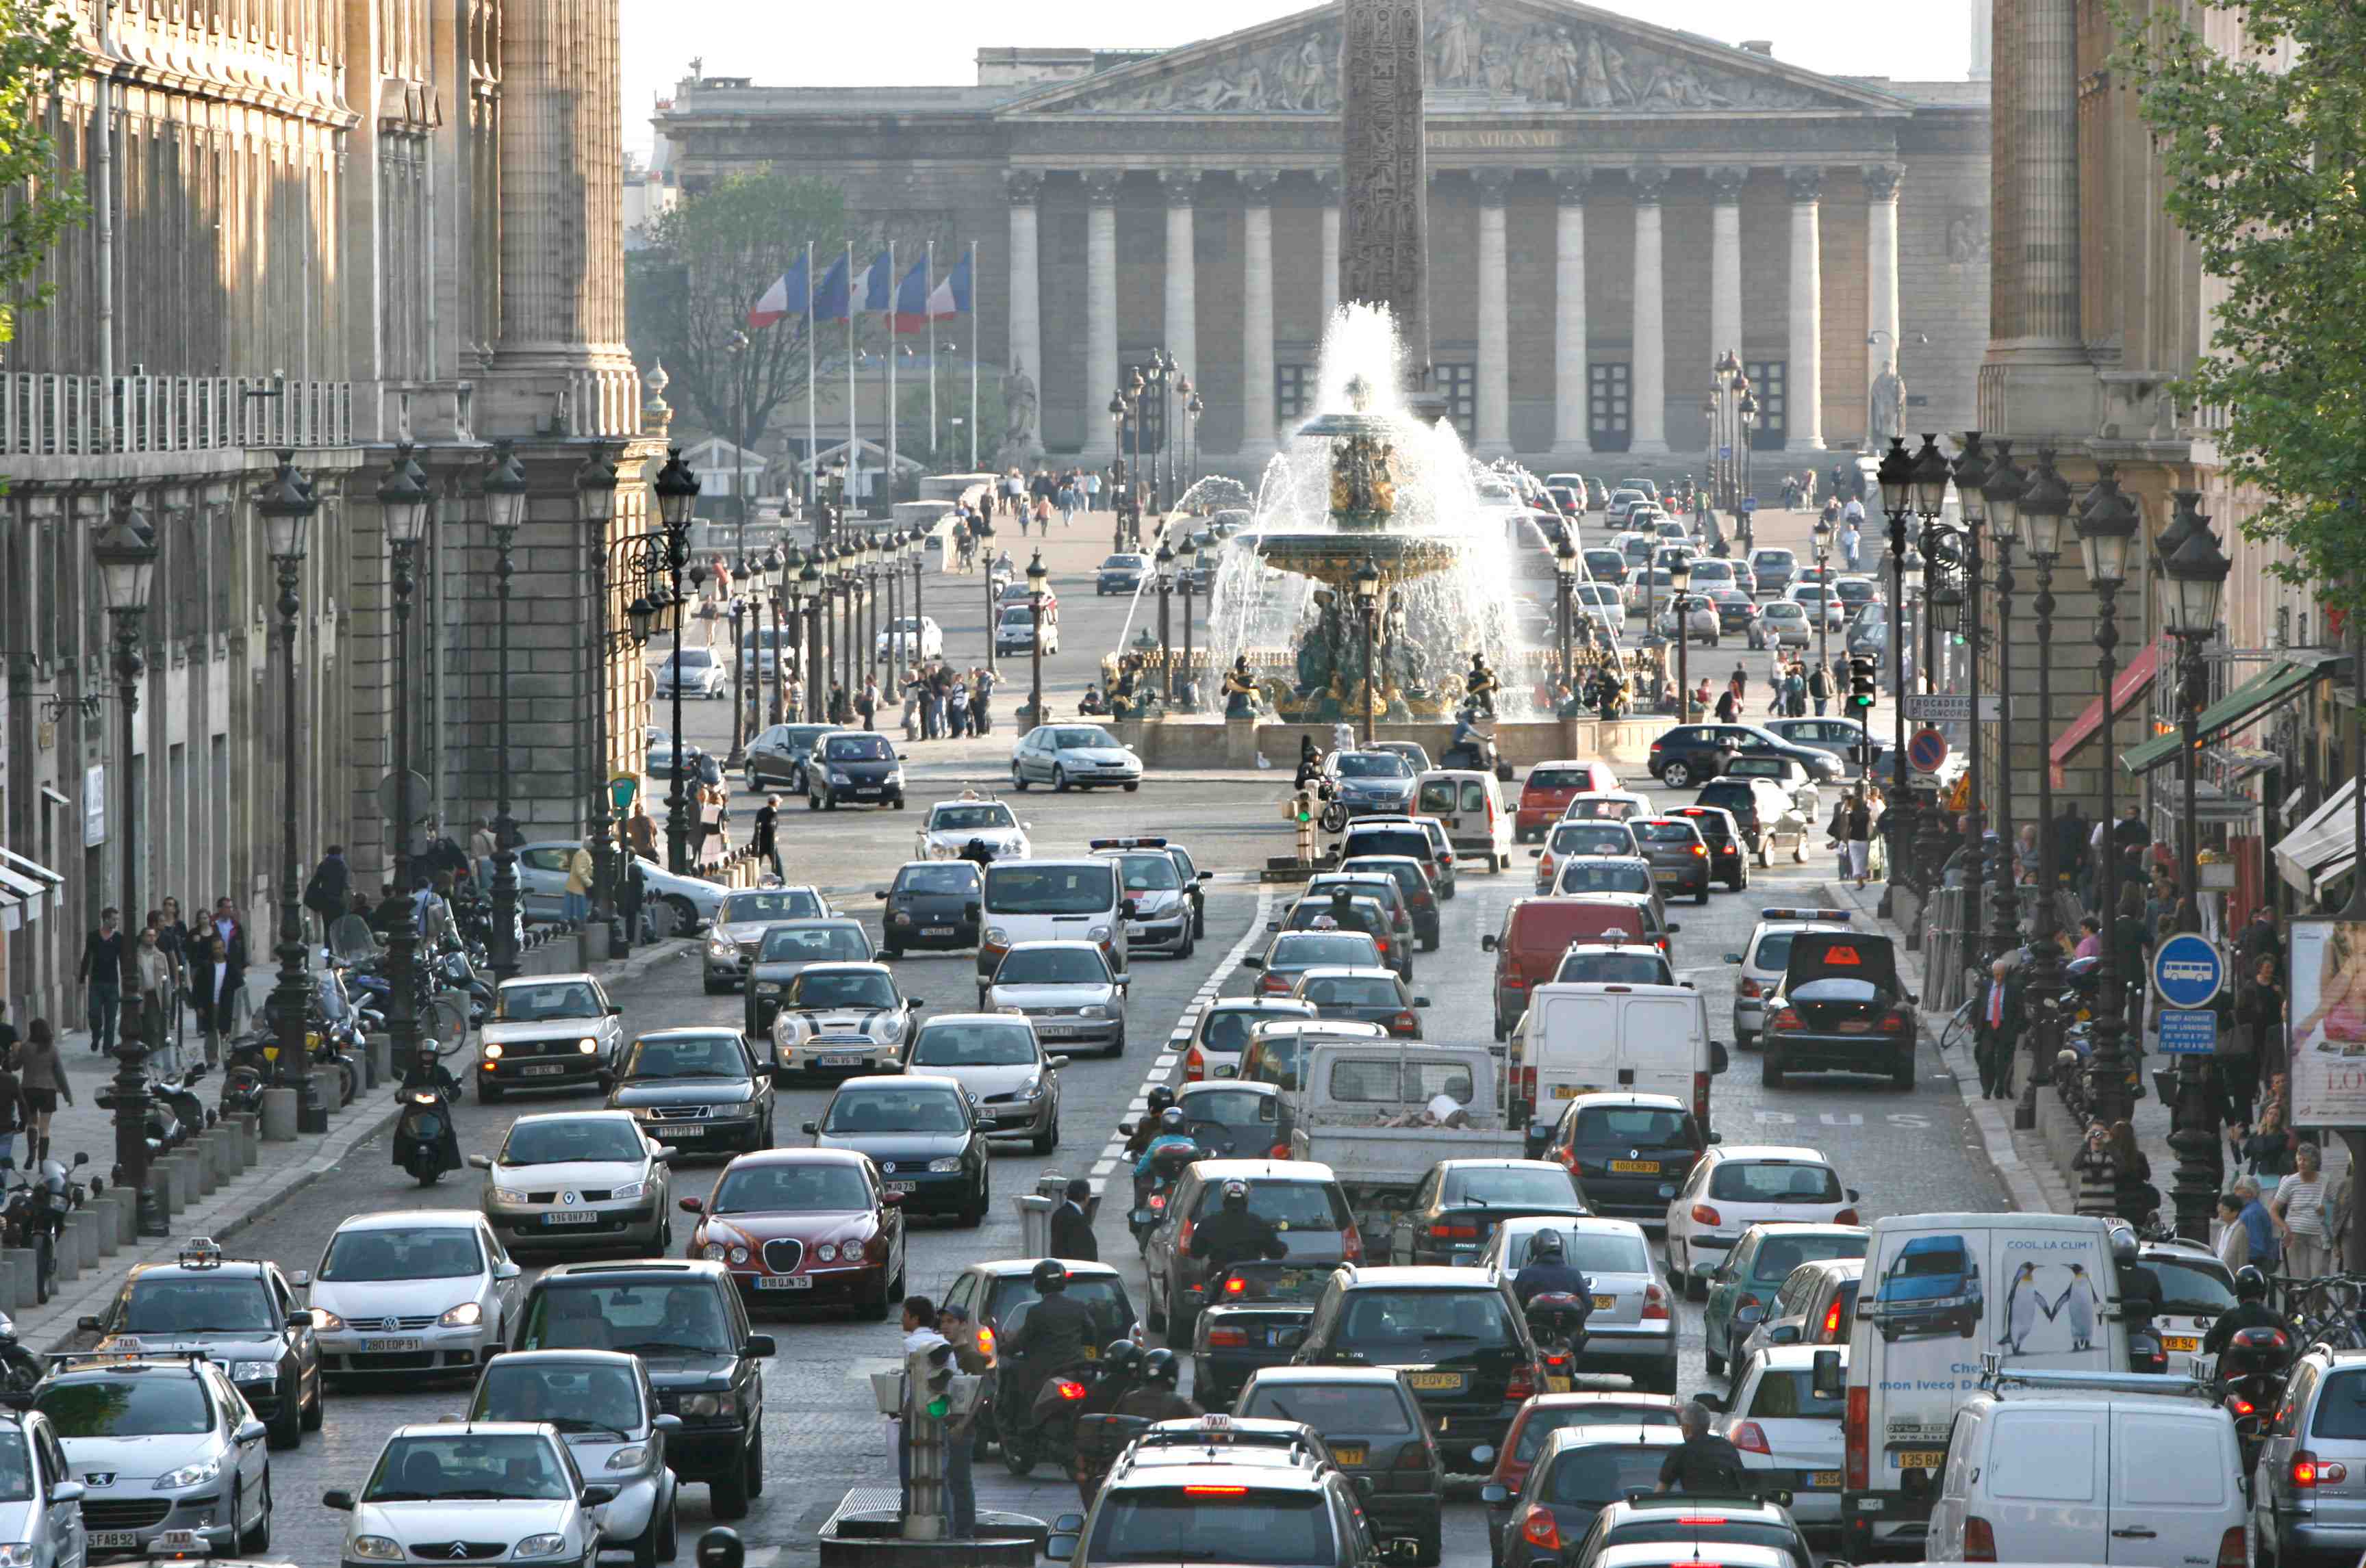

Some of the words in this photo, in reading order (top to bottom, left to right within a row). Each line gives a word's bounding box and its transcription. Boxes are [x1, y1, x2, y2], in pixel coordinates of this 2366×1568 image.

[1911, 699, 1971, 707] TROCADERO
[1753, 1111, 1932, 1129] BUS
[2007, 1242, 2042, 1250] COOL,
[761, 1278, 776, 1287] 818
[798, 1278, 807, 1286] 75
[1599, 1297, 1611, 1308] 95
[120, 1339, 138, 1347] TAXI
[367, 1341, 385, 1351] 280
[409, 1339, 418, 1349] 91
[1879, 1380, 1911, 1390] mon
[1918, 1379, 1955, 1390] Iveco
[1206, 1416, 1227, 1425] TAXI
[1901, 1454, 1922, 1465] 135
[97, 1534, 117, 1546] FAB
[120, 1533, 133, 1545] 92
[166, 1532, 191, 1544] TAXI
